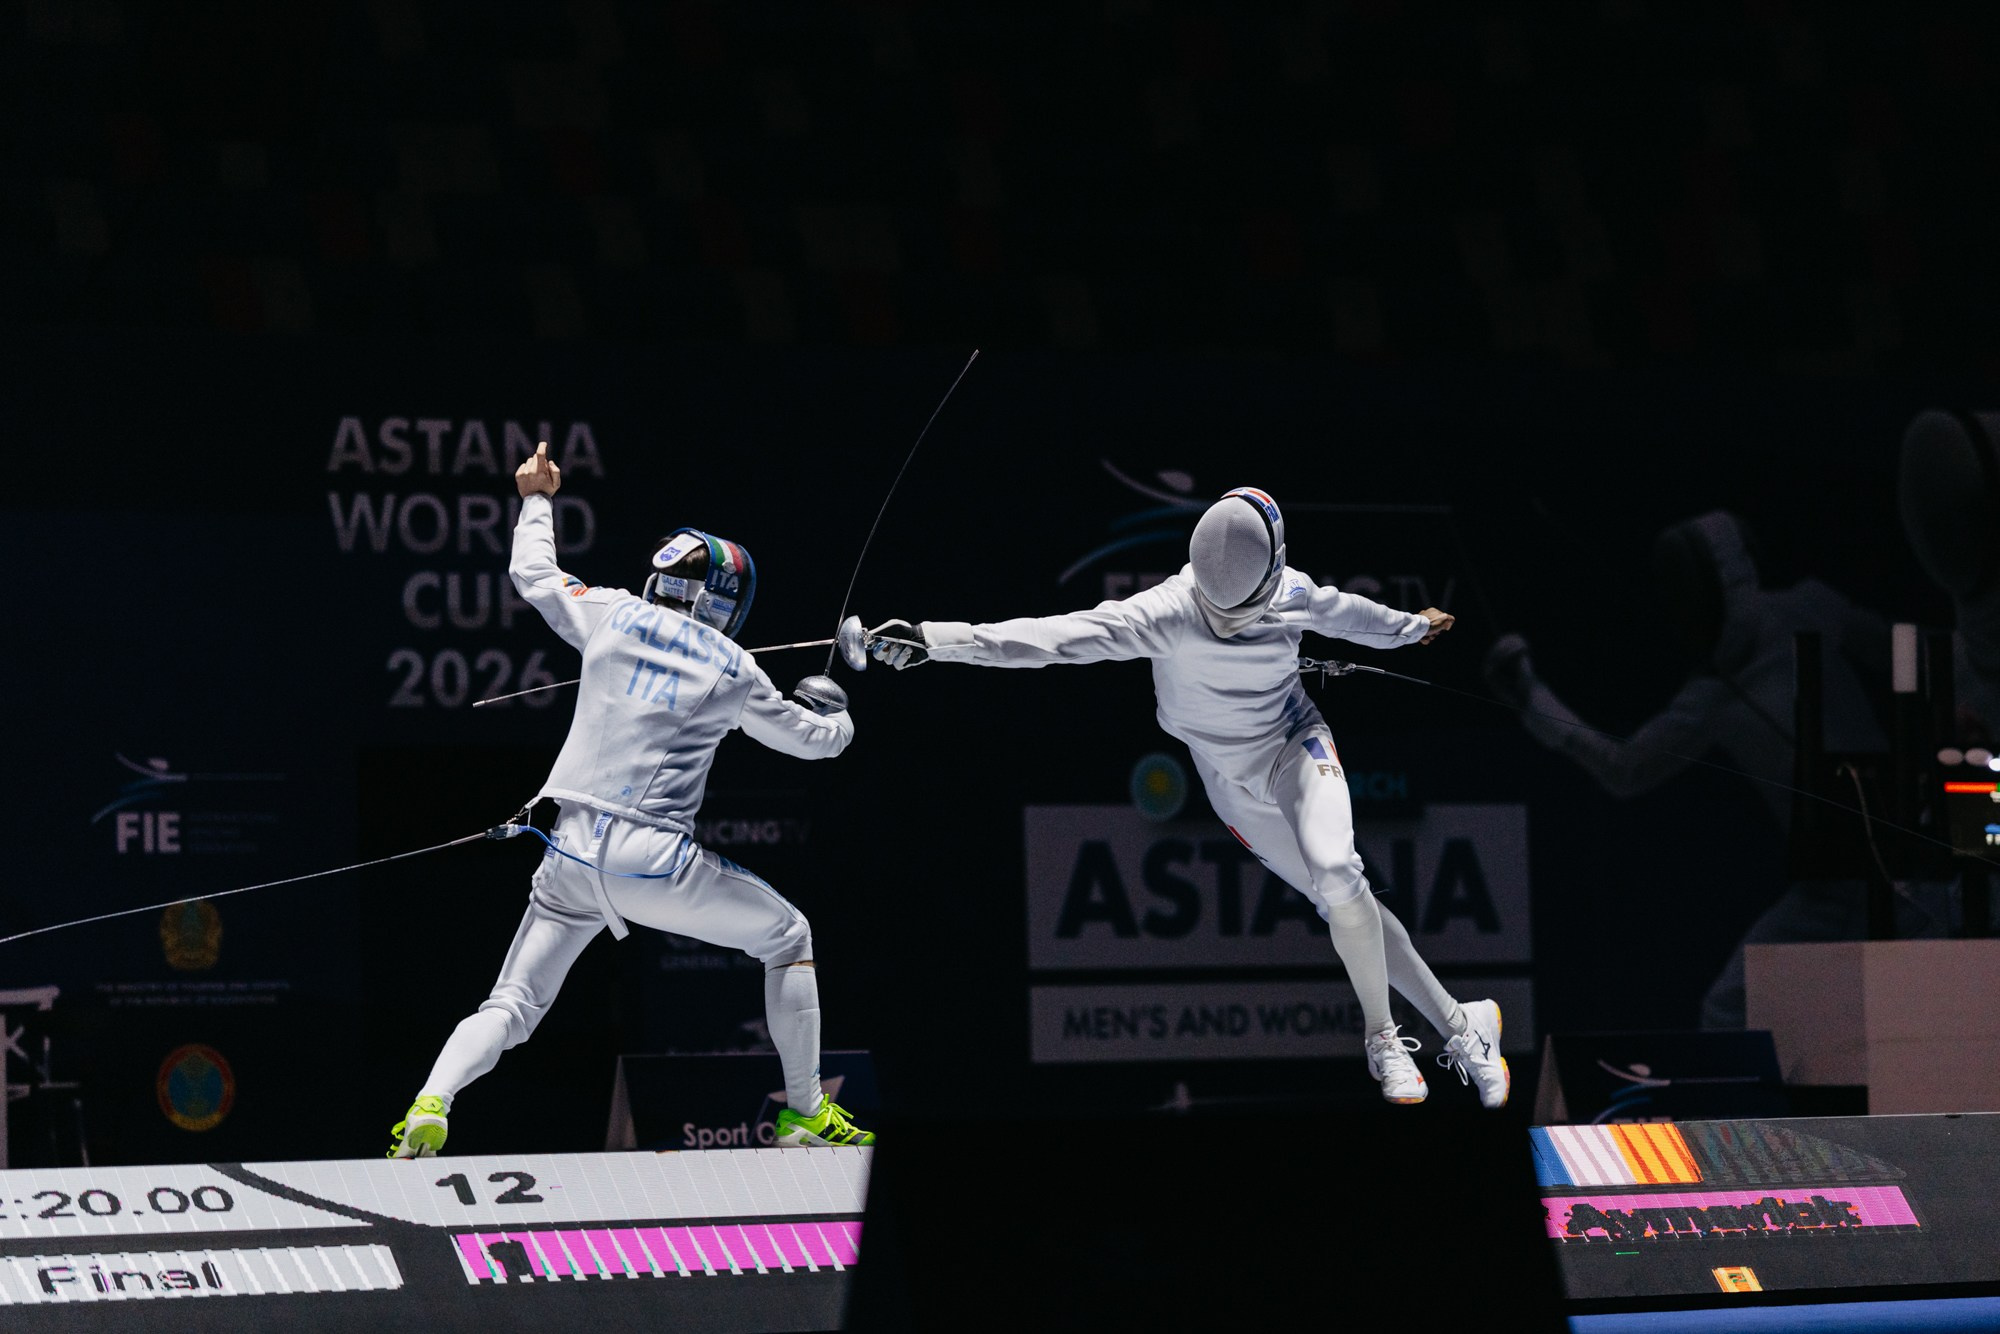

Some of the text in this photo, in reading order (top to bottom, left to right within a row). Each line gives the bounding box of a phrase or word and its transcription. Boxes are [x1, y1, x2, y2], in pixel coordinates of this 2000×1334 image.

[326, 415, 605, 478] ASTANA
[711, 569, 740, 592] ITA
[386, 648, 559, 709] 2026
[626, 657, 681, 711] ITA
[1316, 764, 1344, 780] FR
[1346, 770, 1408, 799] RCH
[116, 811, 181, 853] FIE
[1063, 1004, 1169, 1040] MEN'S
[1174, 1002, 1250, 1037] AND
[683, 1121, 749, 1148] Sport
[0, 1185, 234, 1219] :20.00
[435, 1171, 544, 1206] 12
[37, 1260, 224, 1295] Final
